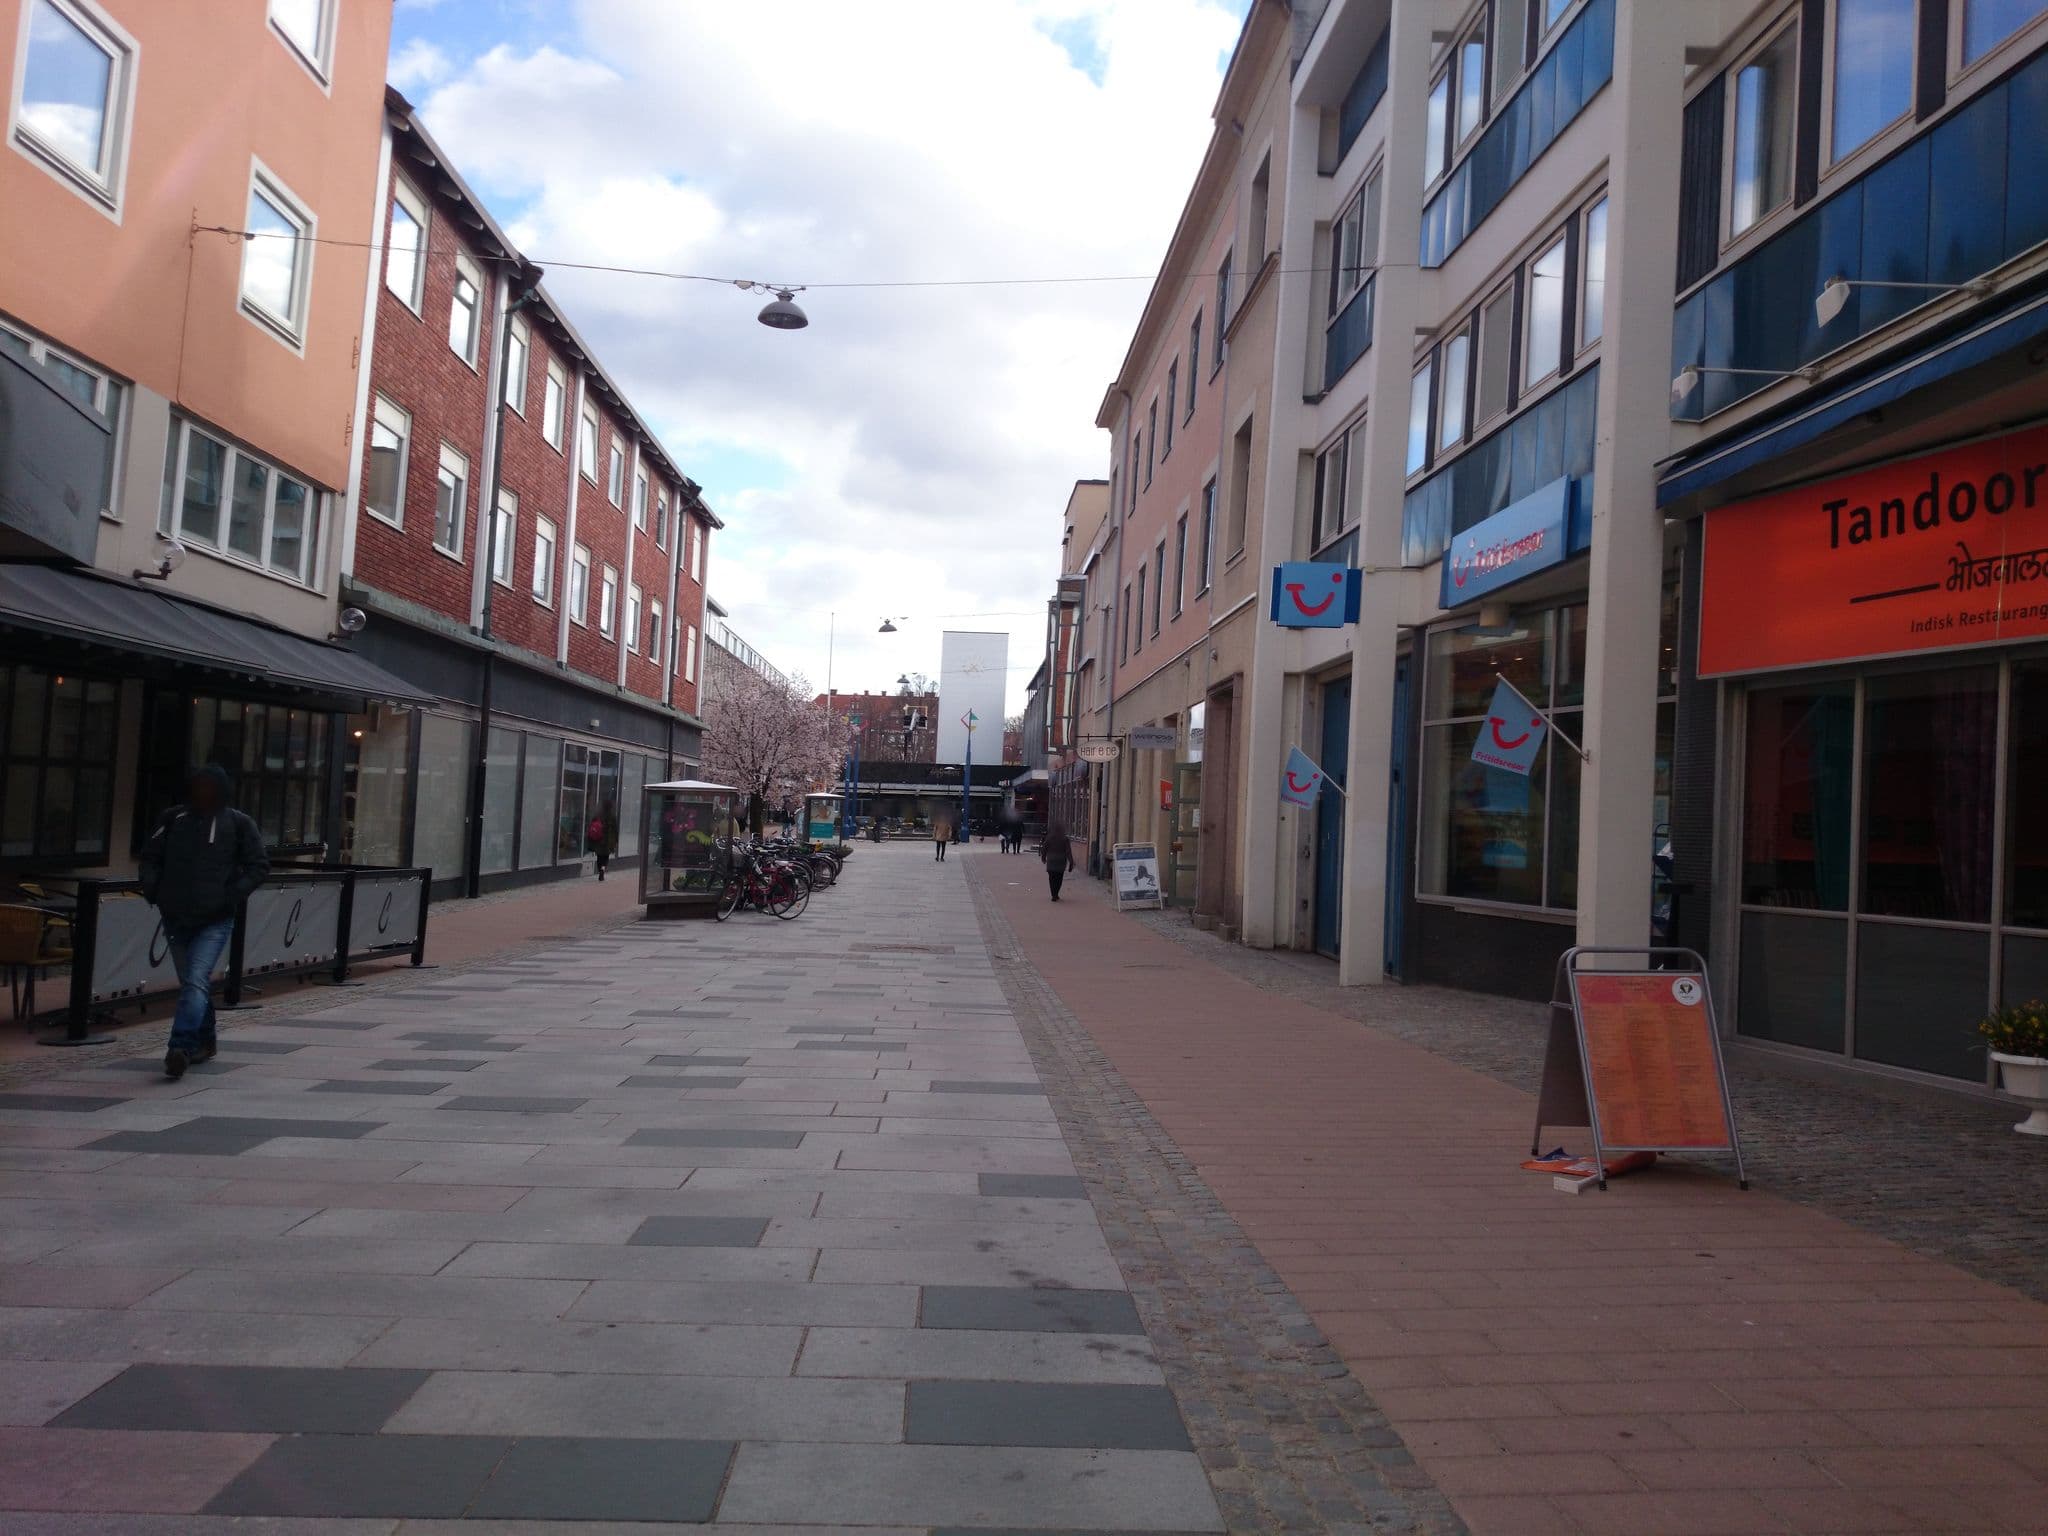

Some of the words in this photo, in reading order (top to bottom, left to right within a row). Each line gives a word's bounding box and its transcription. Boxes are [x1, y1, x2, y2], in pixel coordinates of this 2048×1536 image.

[1822, 465, 2048, 549] Tandoor
[1910, 612, 1953, 632] Indisk
[1959, 604, 2048, 627] Restaurang
